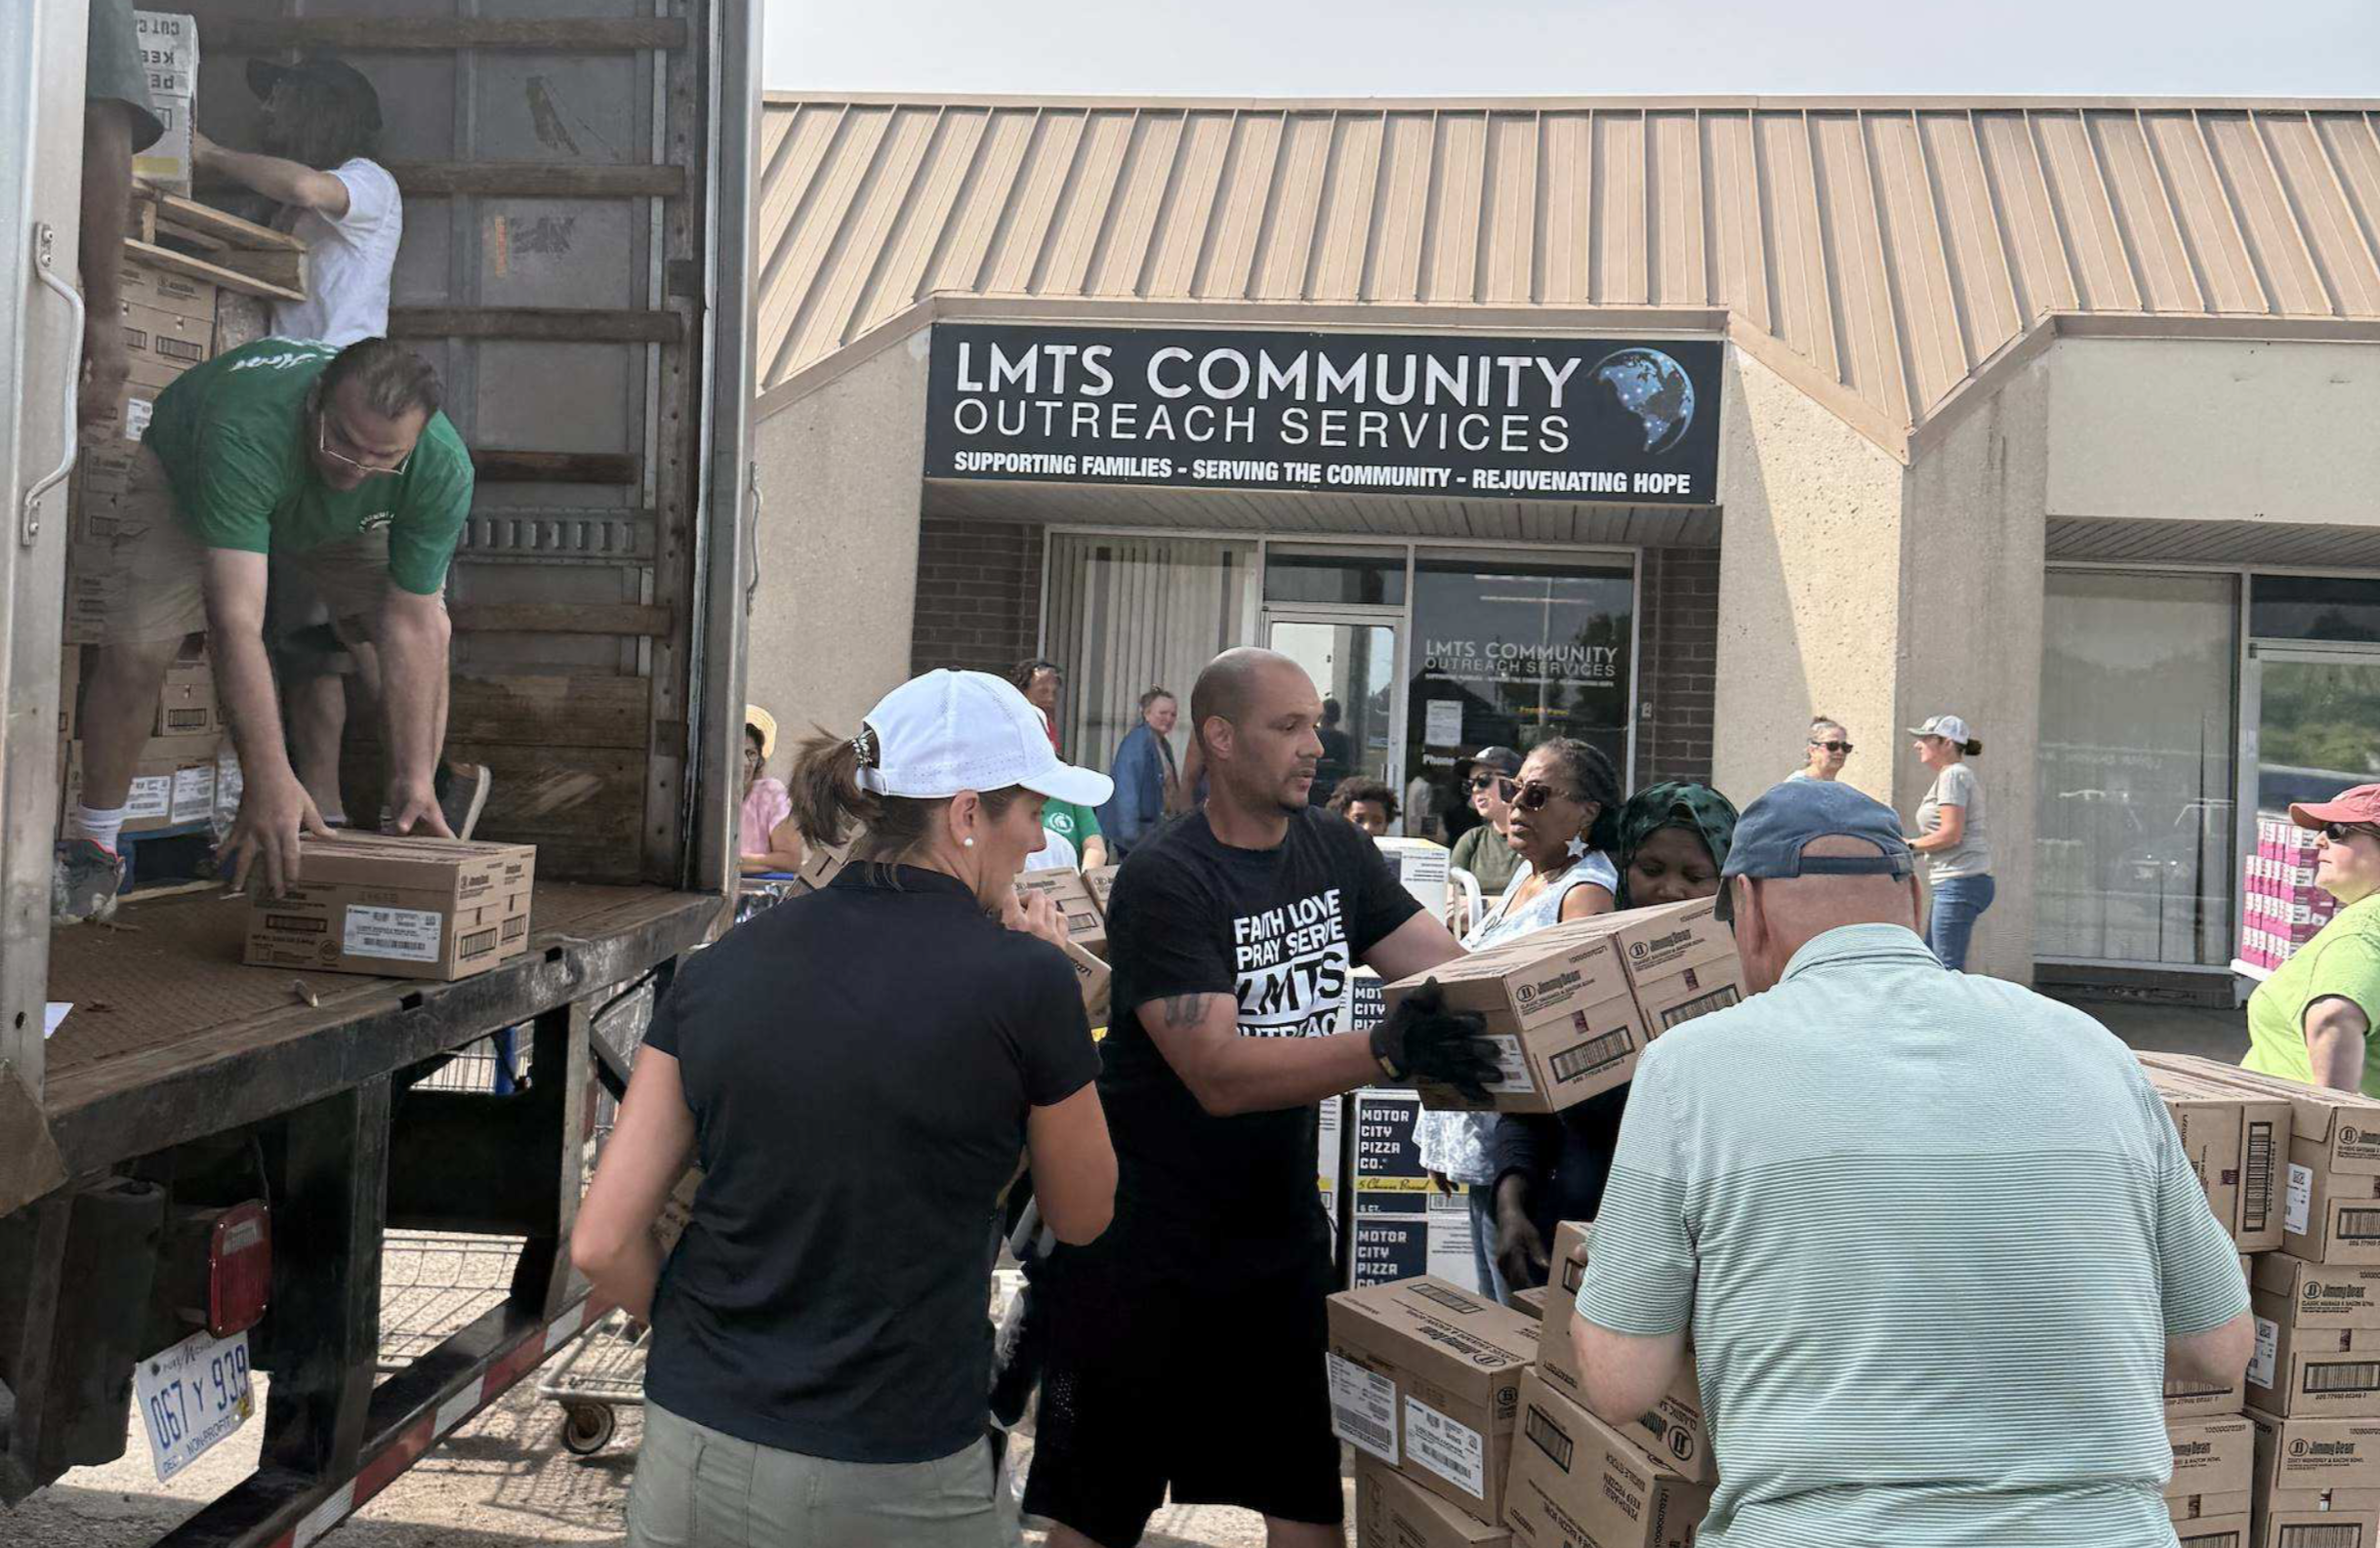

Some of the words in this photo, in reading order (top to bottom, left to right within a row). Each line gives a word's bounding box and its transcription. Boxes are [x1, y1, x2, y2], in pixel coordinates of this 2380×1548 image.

[957, 342, 1115, 396] LMTS
[1147, 346, 1581, 408] COMMUNITY
[954, 398, 1255, 443] OUTREACH
[1280, 407, 1570, 453] SERVICES
[954, 451, 1076, 474] SUPPORTING
[1082, 456, 1172, 478] FAMILIES
[1192, 459, 1279, 482] SERVING
[1283, 462, 1321, 483] THE
[1327, 464, 1452, 488] COMMUNITY
[1472, 469, 1627, 493] REJUVENATING
[1633, 472, 1691, 495] HOPE
[1426, 639, 1475, 658] LMTS
[1486, 642, 1619, 664] COMMUNITY
[1424, 657, 1520, 672] OUTREACH
[1526, 661, 1616, 677] SERVICES
[1234, 908, 1285, 944] FAITH
[1288, 888, 1340, 928] LOVE
[1236, 937, 1281, 970] PRAY
[1286, 916, 1345, 956] SERVE
[1237, 951, 1345, 1015] LMTS
[1354, 988, 1382, 999] MOT
[1354, 1003, 1385, 1015] CITY
[1361, 1109, 1410, 1121] MOTOR
[1361, 1125, 1392, 1137] CITY
[1360, 1142, 1401, 1154] PIZZA
[1358, 1230, 1407, 1242] MOTOR
[1358, 1246, 1389, 1258] CITY
[1357, 1263, 1398, 1275] PIZZA
[150, 1379, 188, 1449] 067
[192, 1376, 204, 1412] Y
[212, 1343, 249, 1411] 939
